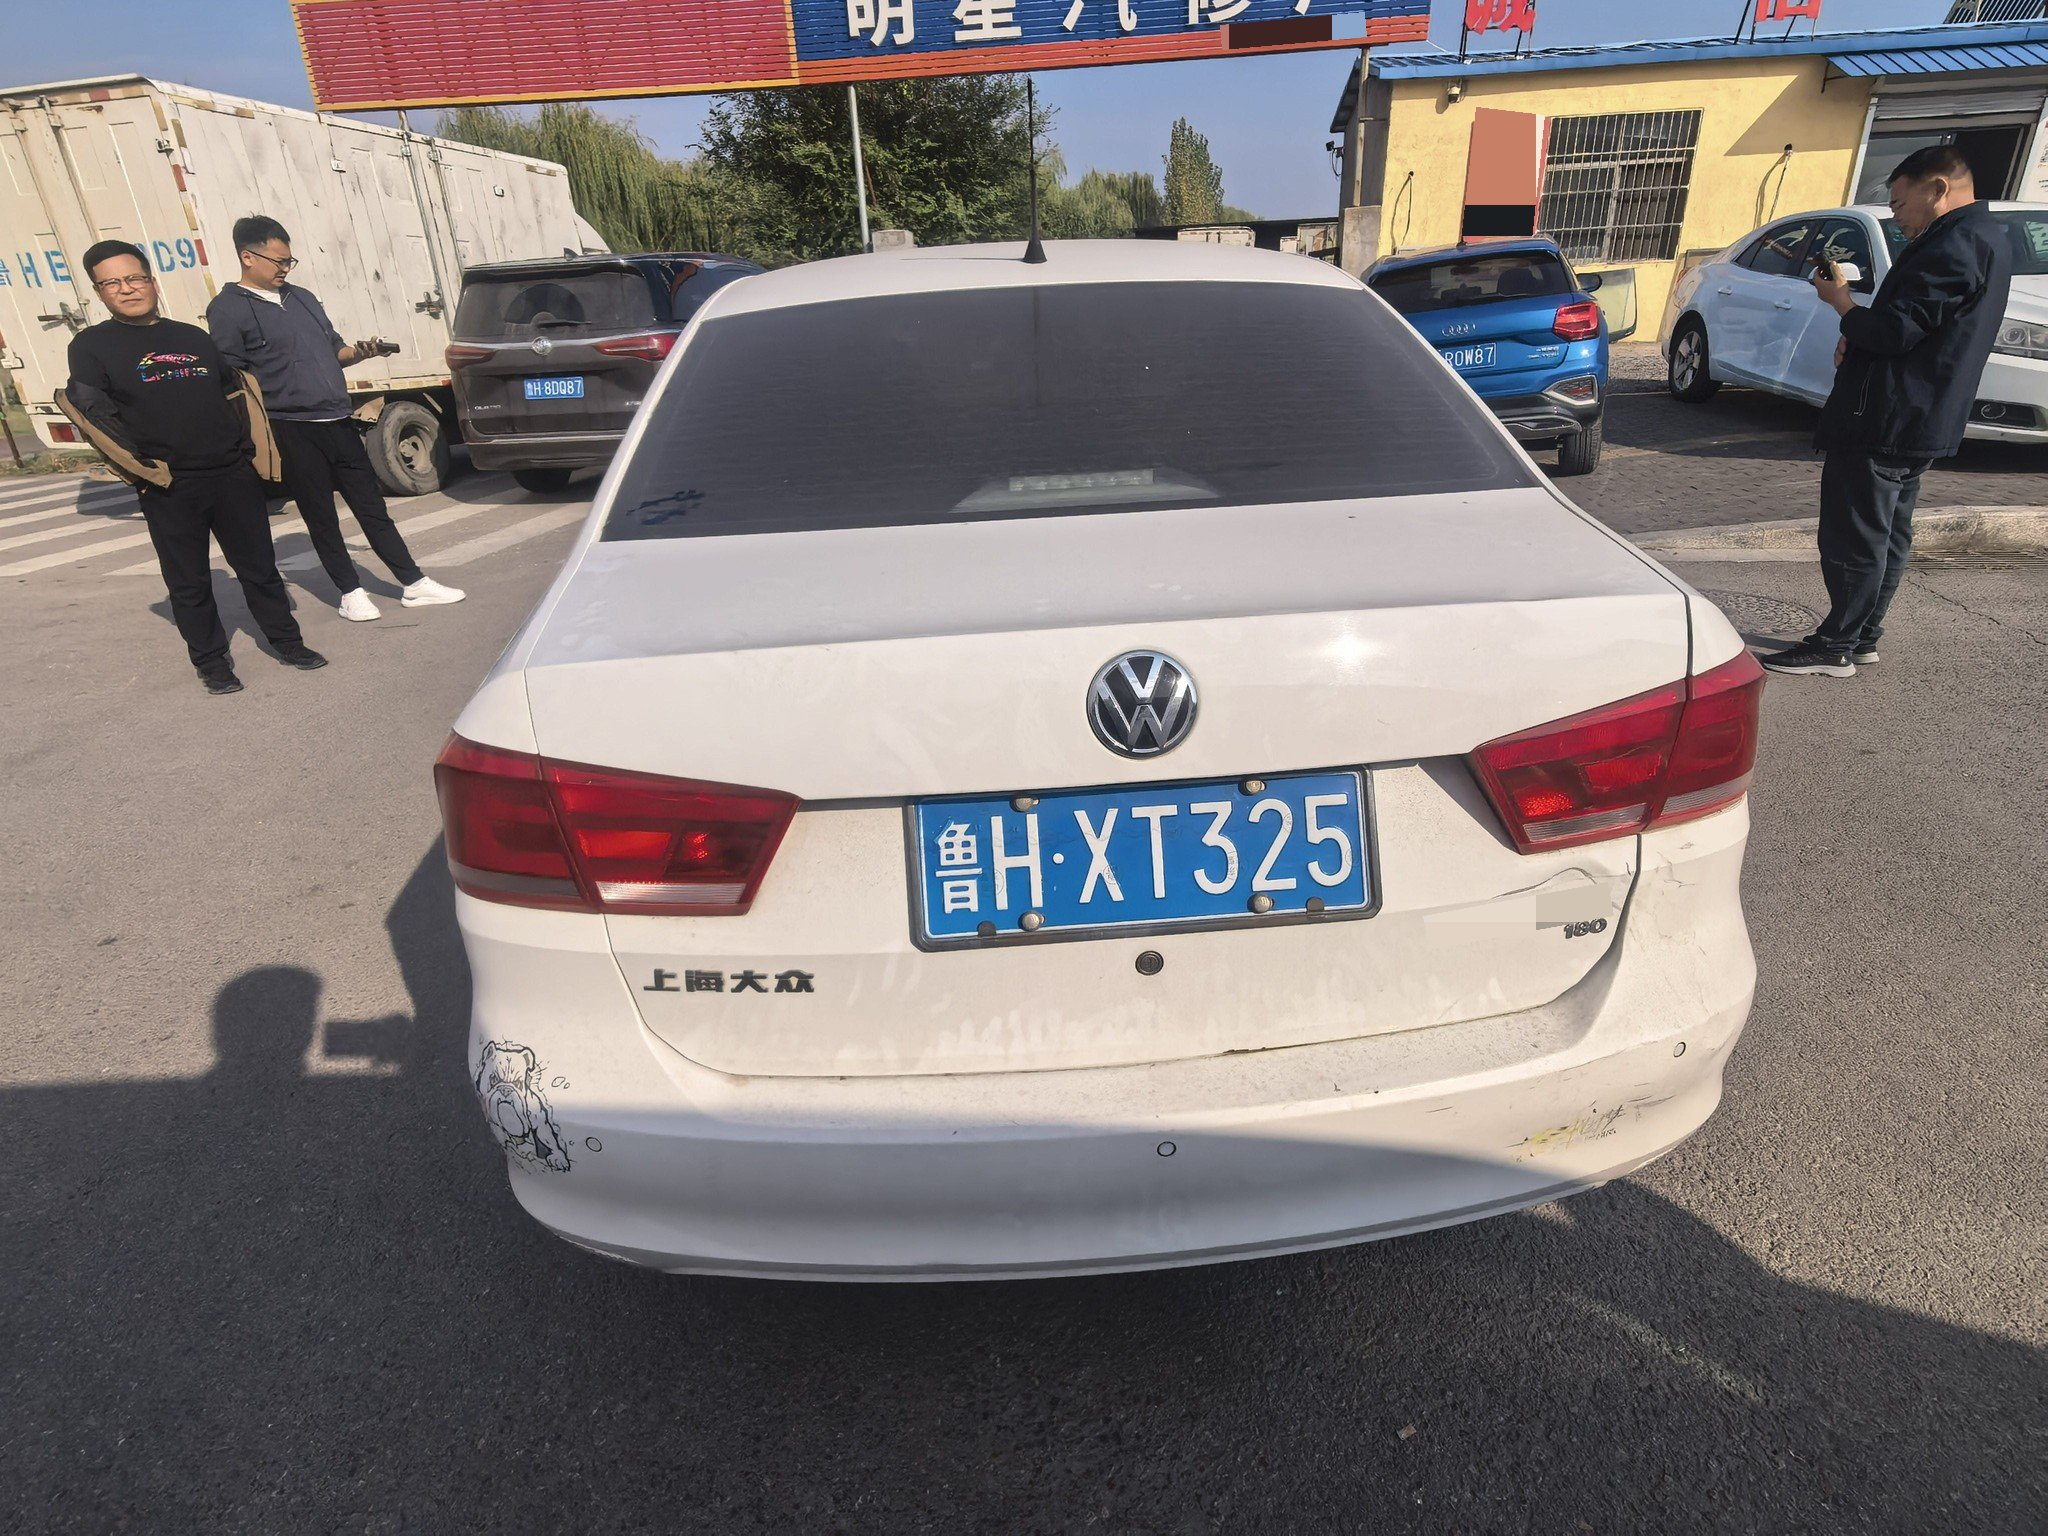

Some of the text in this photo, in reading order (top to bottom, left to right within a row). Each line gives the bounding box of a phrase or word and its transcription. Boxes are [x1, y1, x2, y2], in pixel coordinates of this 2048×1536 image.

[935, 793, 1354, 914] 鲁H·XT325
[1563, 918, 1608, 939] 180
[643, 968, 815, 993] 上海大众
